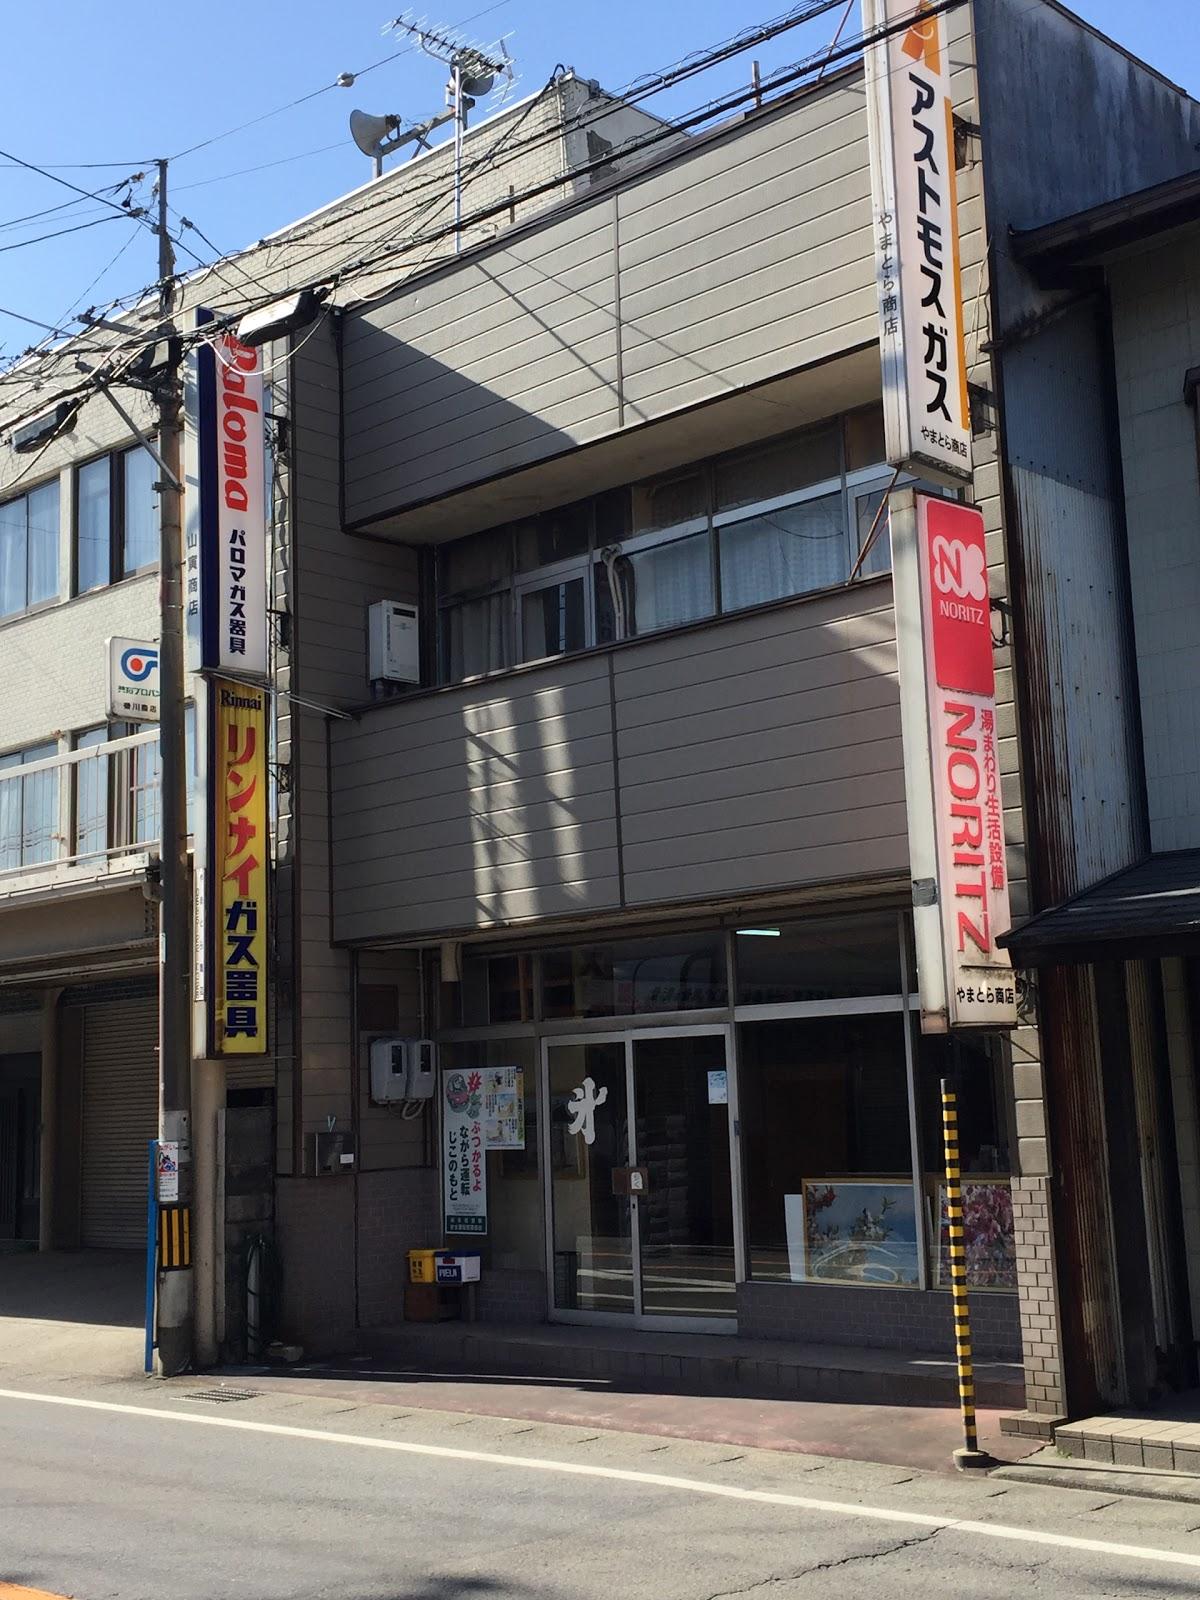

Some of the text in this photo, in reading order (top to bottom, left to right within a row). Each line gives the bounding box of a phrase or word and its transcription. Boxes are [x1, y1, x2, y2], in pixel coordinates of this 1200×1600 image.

[878, 212, 898, 337] やまとら商店
[908, 71, 953, 423] アストモスガス
[222, 336, 259, 512] Paloma
[921, 425, 968, 458] やまとら商店
[187, 532, 199, 616] 山寅商店
[228, 529, 247, 656] パロマガス器具
[940, 599, 985, 625] NORITZ
[220, 689, 262, 711] Rinnai
[943, 701, 992, 954] NORITZ
[980, 709, 1004, 890] 湯まわり生活設備
[222, 724, 260, 1038] リンナイガス器具
[955, 985, 1015, 1006] やまとら商店
[448, 1130, 458, 1201] じこのもと
[459, 1126, 470, 1196] ながら運転
[471, 1121, 482, 1192] ぶつかるよ
